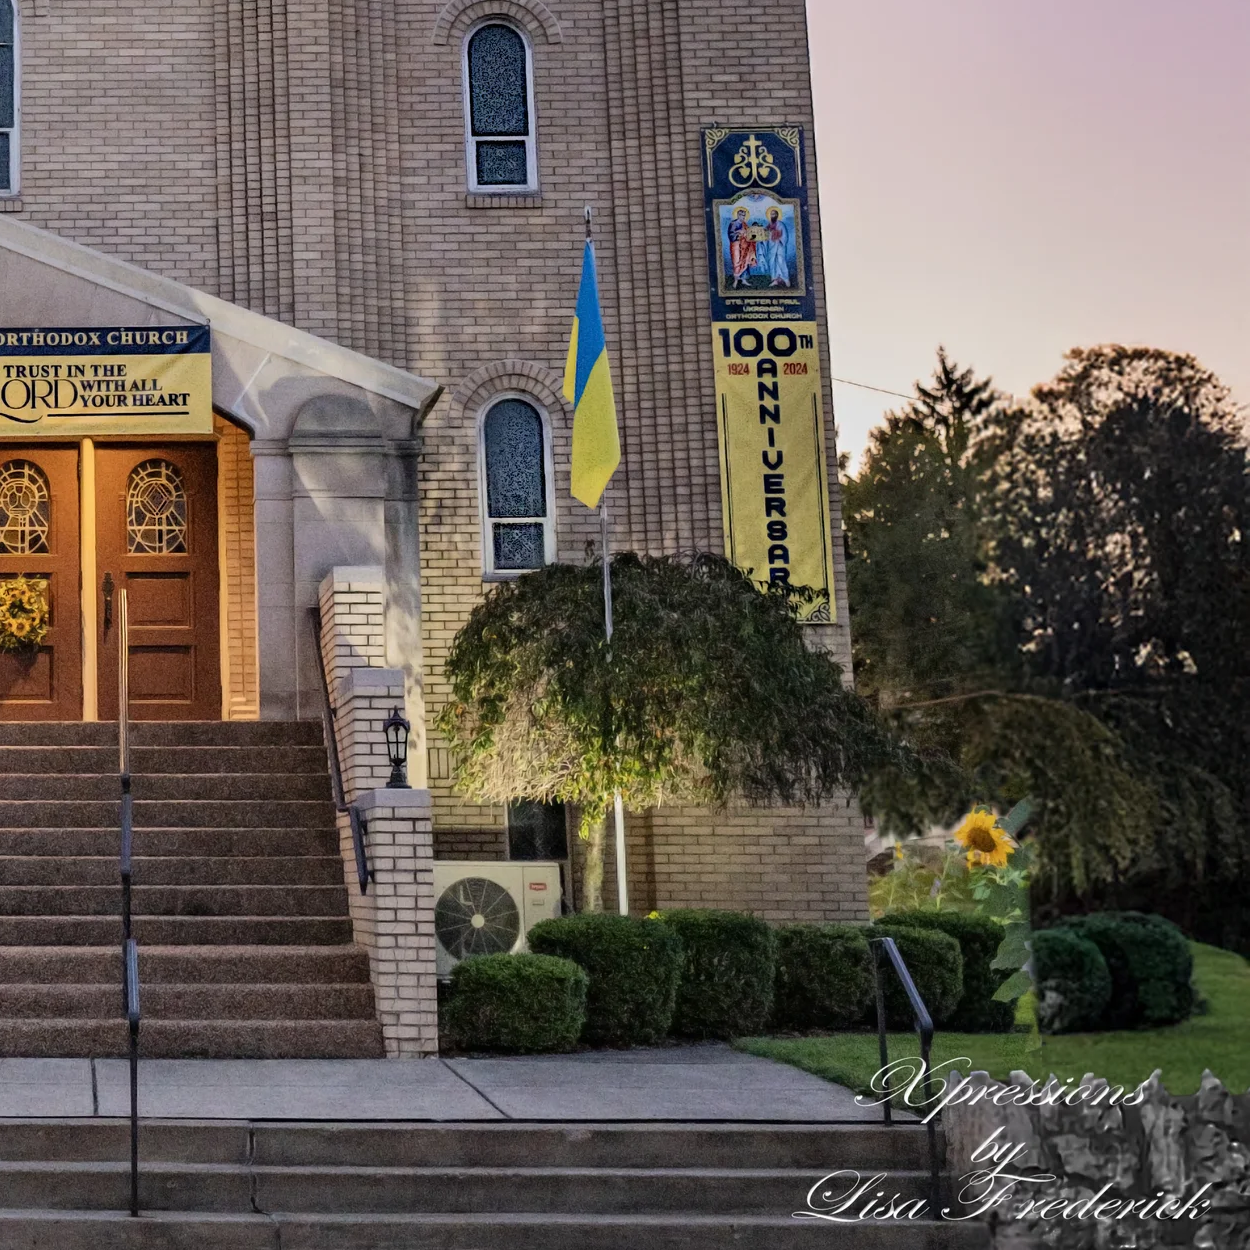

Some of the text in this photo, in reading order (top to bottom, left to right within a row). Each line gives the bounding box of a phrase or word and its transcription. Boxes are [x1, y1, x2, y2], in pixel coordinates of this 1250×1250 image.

[106, 330, 189, 345] CHURCH
[3, 363, 127, 378] TRUST IN THE
[727, 363, 808, 375] 1924 2024
[79, 379, 126, 392] WITH
[128, 378, 163, 392] ALL
[79, 392, 190, 408] YOUR HEART
[756, 358, 791, 588] ANNIVERSAR
